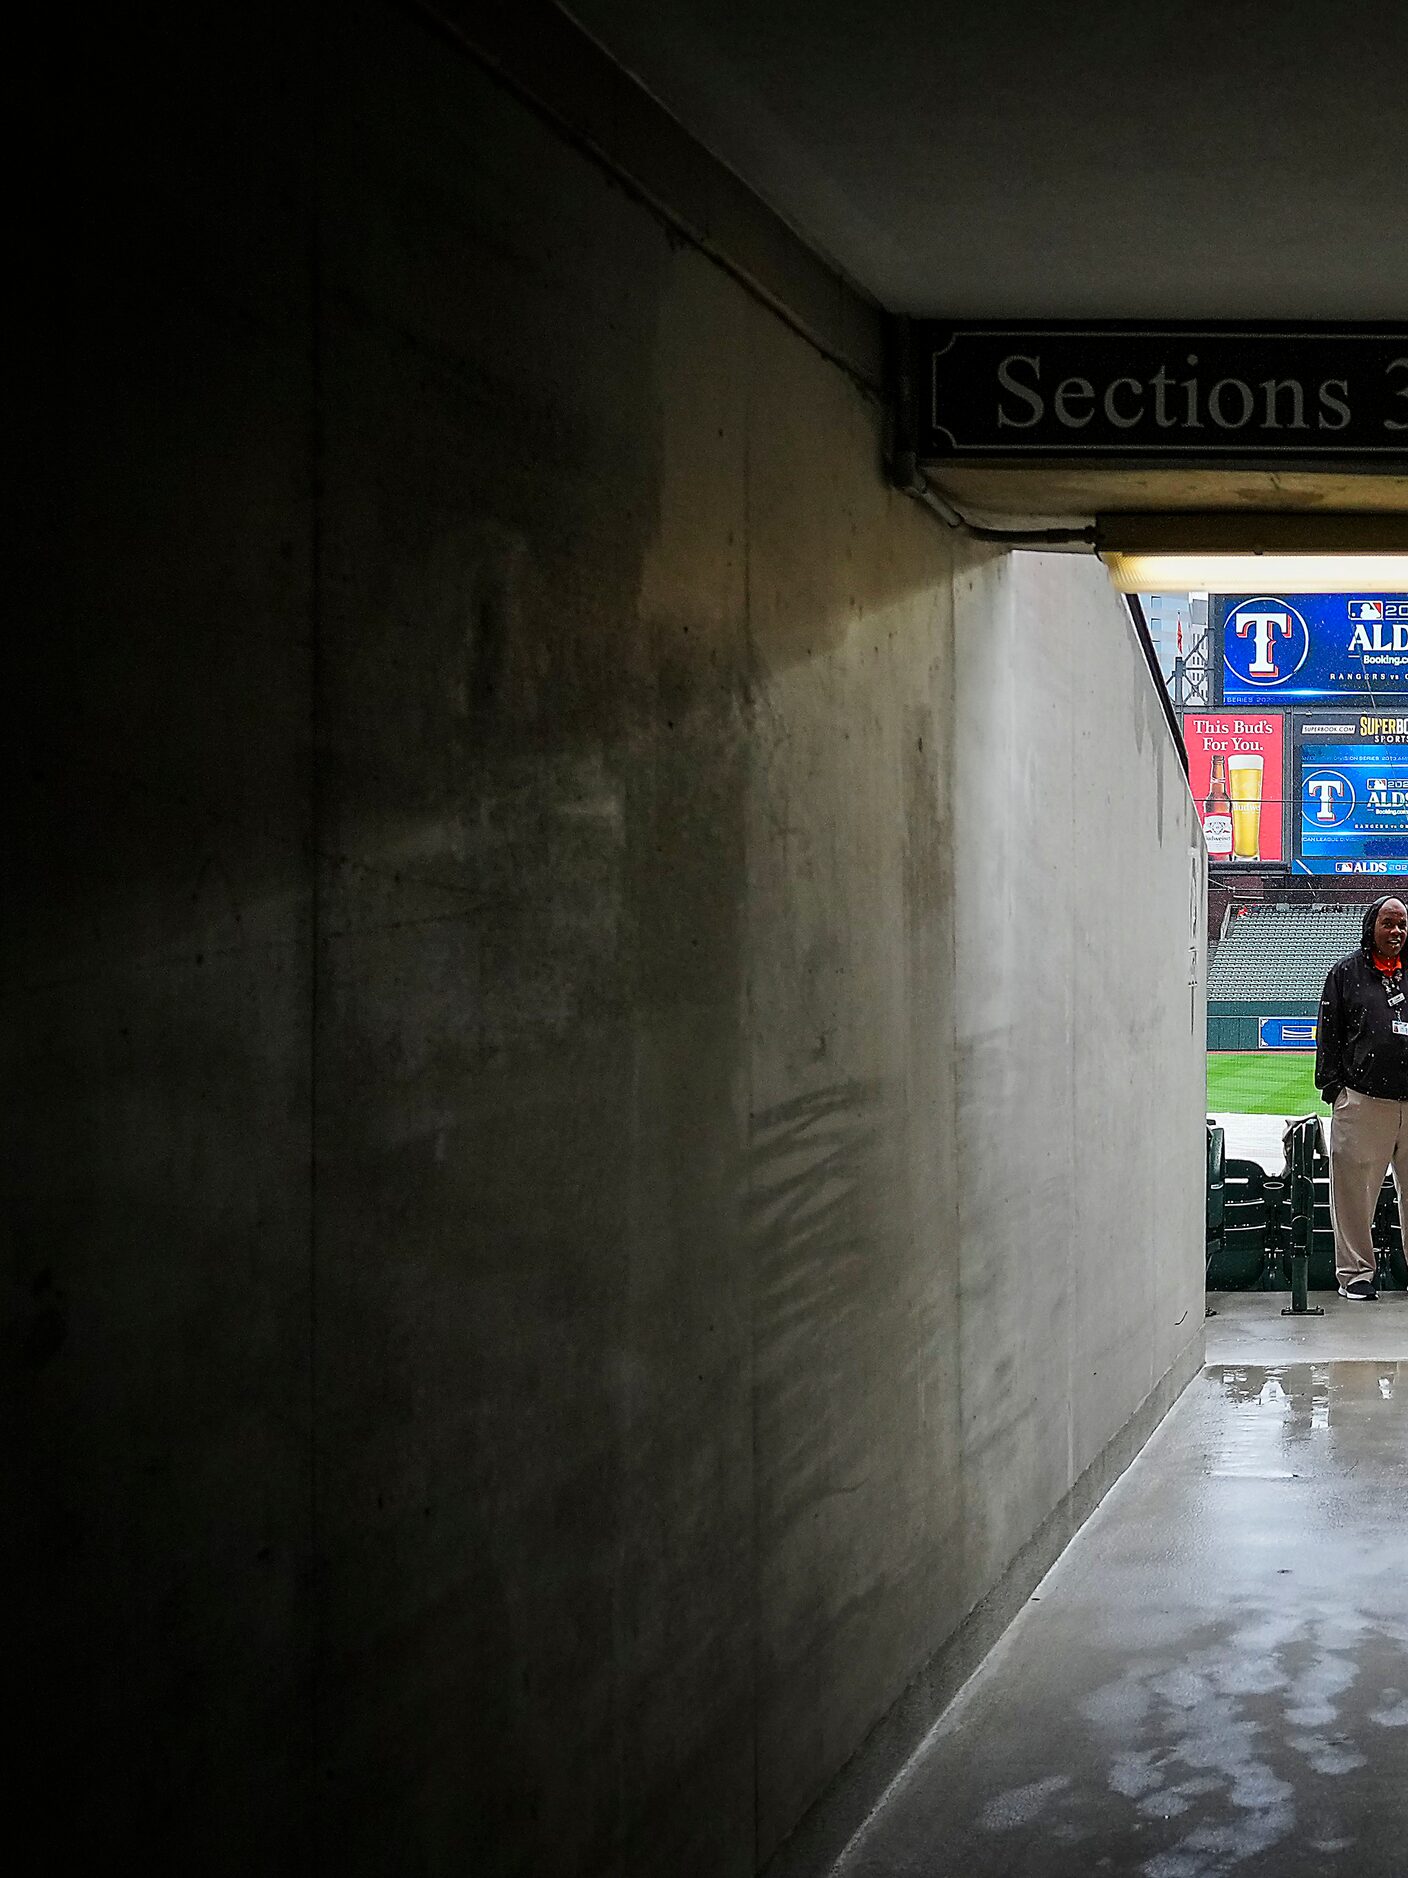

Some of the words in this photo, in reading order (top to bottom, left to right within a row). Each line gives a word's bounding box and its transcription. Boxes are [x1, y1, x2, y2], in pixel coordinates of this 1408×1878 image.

[997, 353, 1353, 429] Sections
[1236, 613, 1292, 678] T
[1194, 720, 1229, 734] This
[1233, 720, 1274, 734] Bud's
[1203, 737, 1228, 751] For
[1231, 737, 1264, 751] You.
[1354, 862, 1388, 873] ALDS
